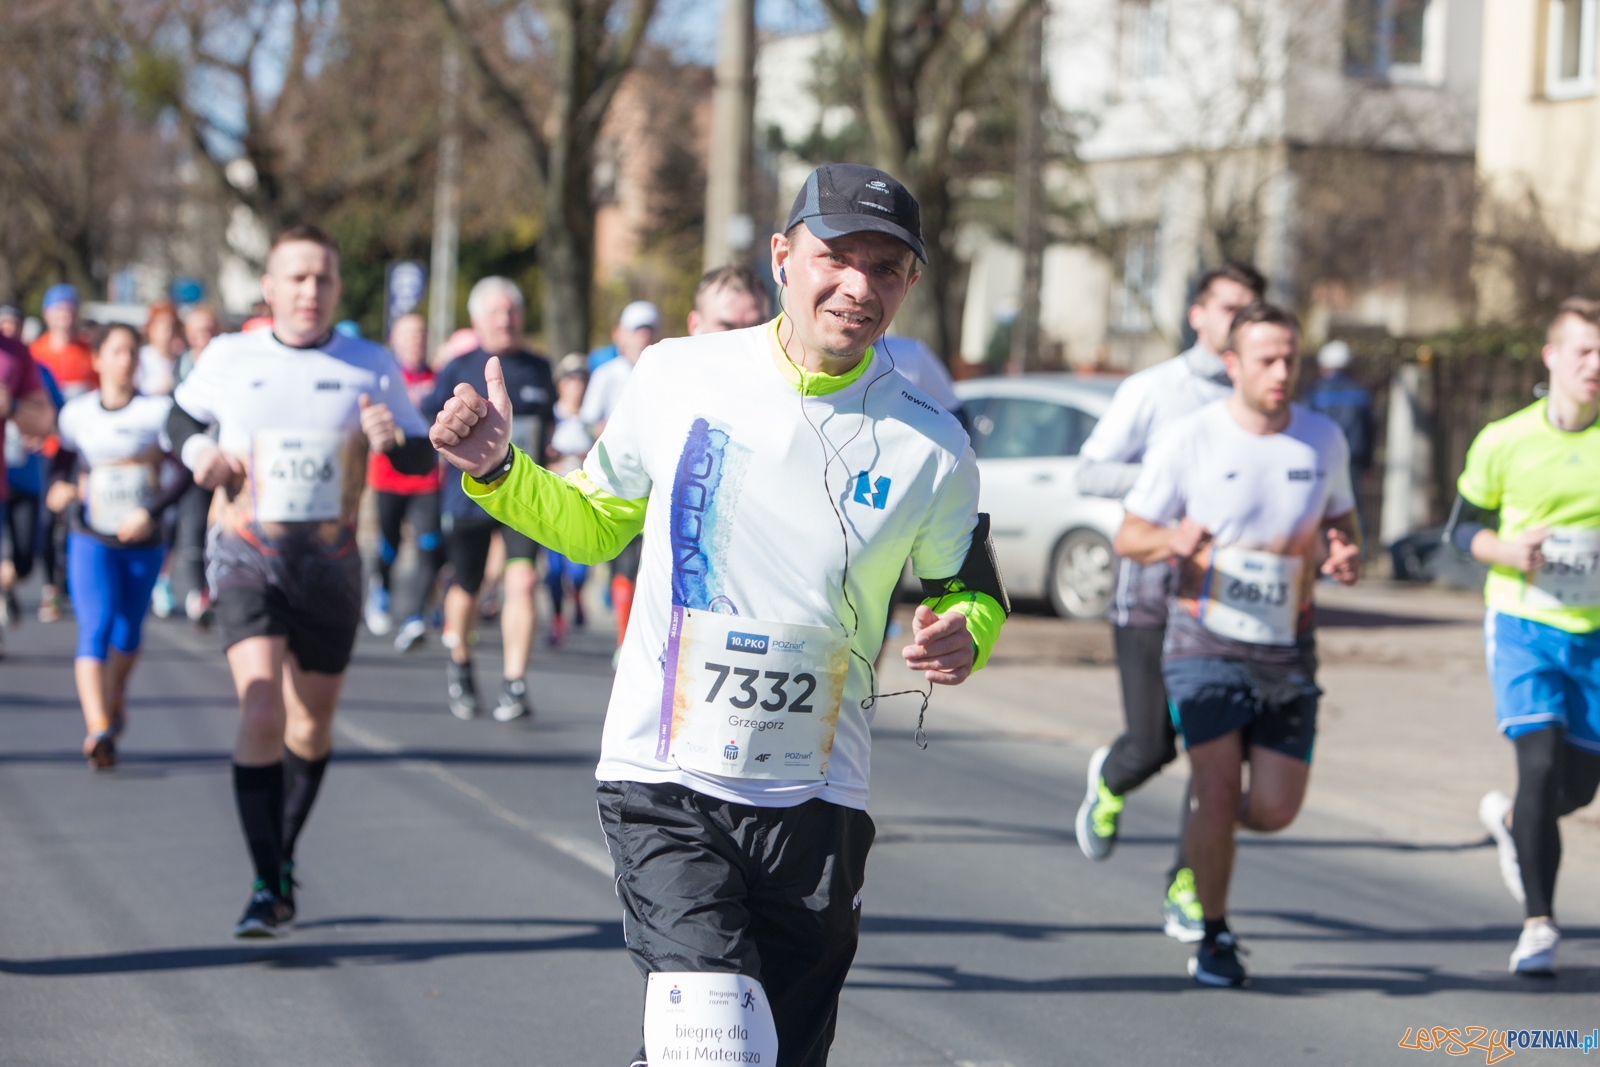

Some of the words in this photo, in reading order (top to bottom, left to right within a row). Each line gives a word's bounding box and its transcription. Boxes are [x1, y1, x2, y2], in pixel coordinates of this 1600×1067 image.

[901, 390, 940, 415] newline
[675, 449, 714, 576] NCDC
[744, 639, 766, 650] PKO
[704, 661, 817, 713] 7332
[728, 715, 785, 732] Grzegorz
[755, 753, 772, 762] 4F
[675, 1023, 723, 1043] biegnę
[728, 1024, 749, 1041] dla
[662, 1046, 682, 1061] Ani
[686, 1046, 690, 1060] i
[694, 1047, 761, 1064] Mateusza
